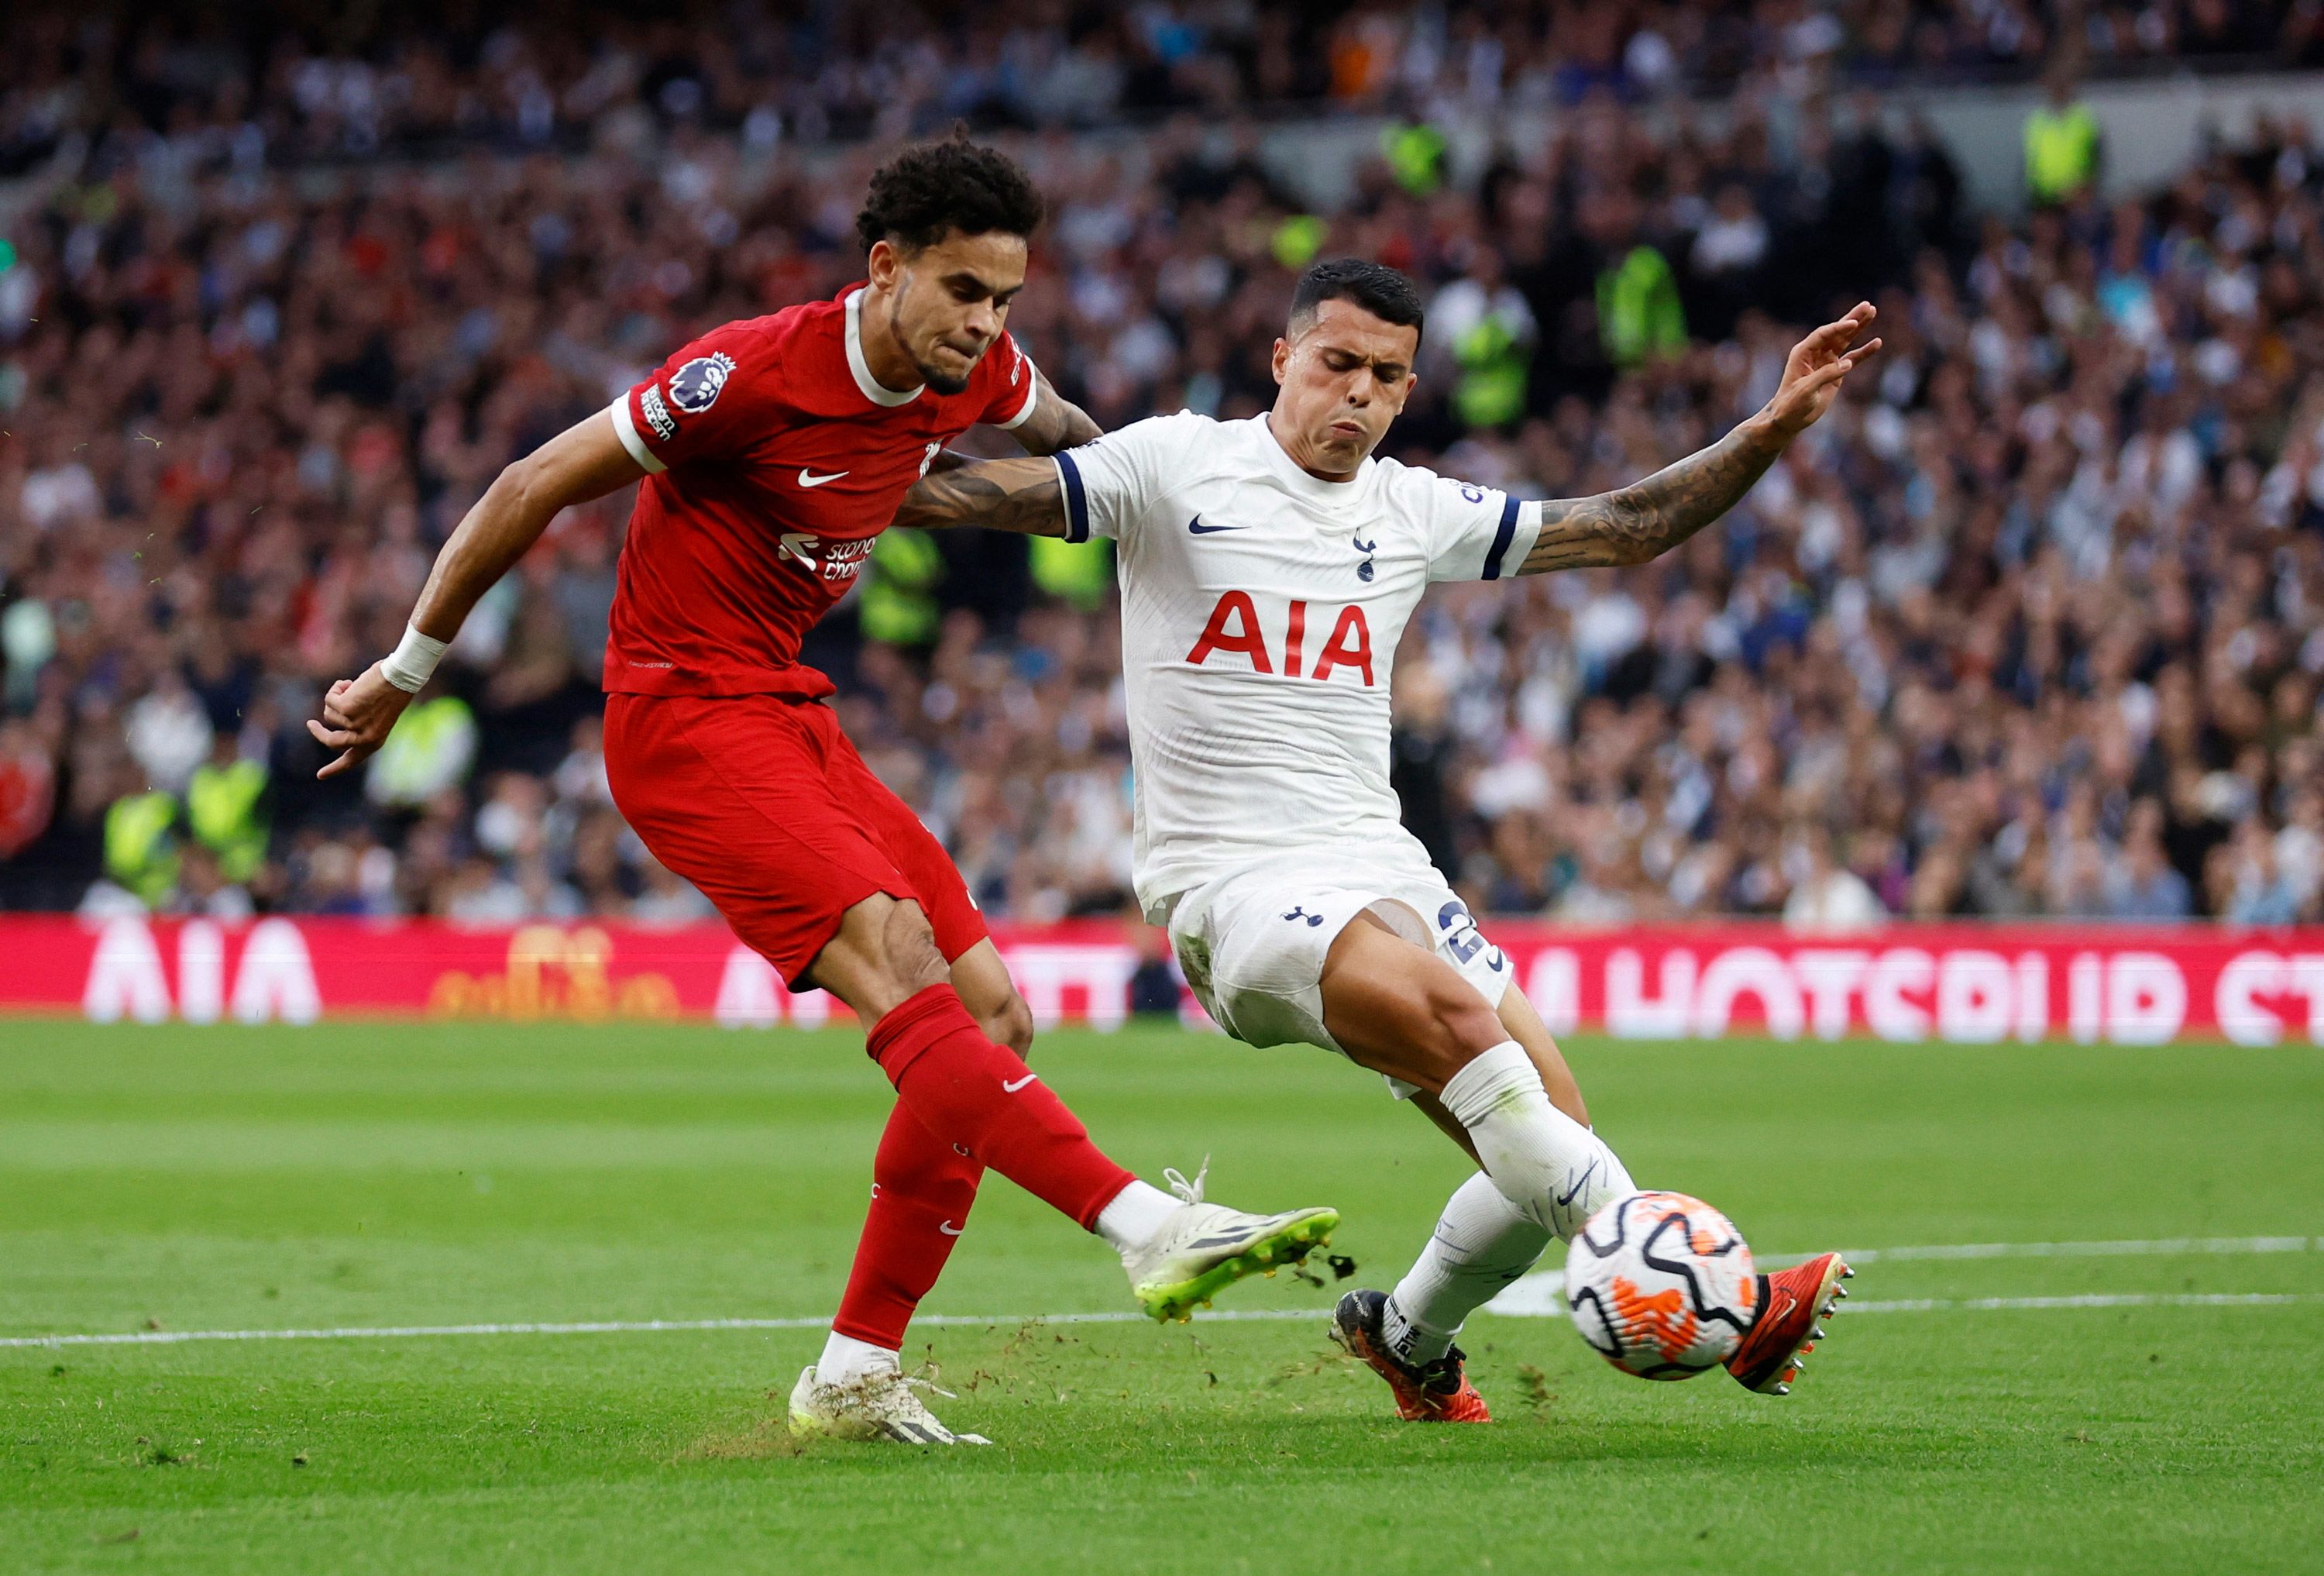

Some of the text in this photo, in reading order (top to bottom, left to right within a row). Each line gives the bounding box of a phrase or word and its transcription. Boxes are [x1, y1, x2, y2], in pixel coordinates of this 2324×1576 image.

[642, 403, 671, 441] racism
[651, 397, 675, 431] room
[1186, 590, 1374, 686] AIA
[83, 916, 321, 1024] AIA
